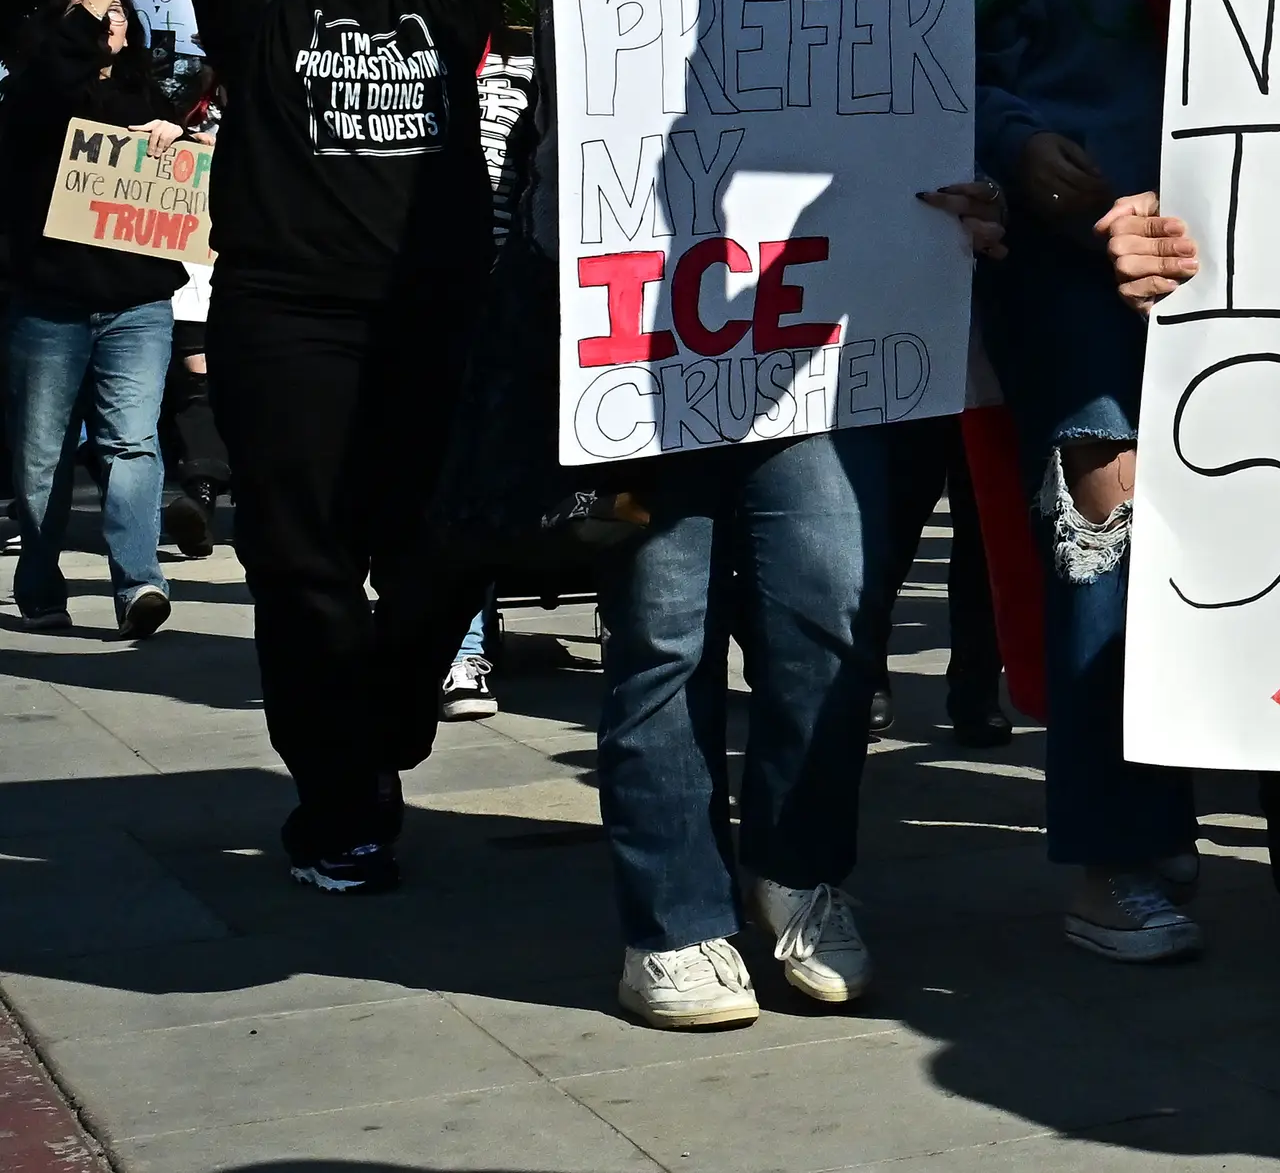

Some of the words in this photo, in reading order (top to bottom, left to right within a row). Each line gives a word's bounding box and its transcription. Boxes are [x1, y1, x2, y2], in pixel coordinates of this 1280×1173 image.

[341, 32, 370, 56] I'M
[331, 81, 361, 110] I'M
[367, 82, 424, 110] DOING
[324, 111, 366, 140] SIDE
[368, 112, 438, 143] QUESTS
[69, 128, 132, 168] MY
[134, 139, 211, 188] PEOP
[66, 169, 104, 197] are
[114, 178, 156, 203] NOT
[581, 127, 745, 245] MY
[89, 201, 199, 251] TRUMP
[577, 237, 841, 366] ICE
[574, 333, 930, 458] CRUSHED
